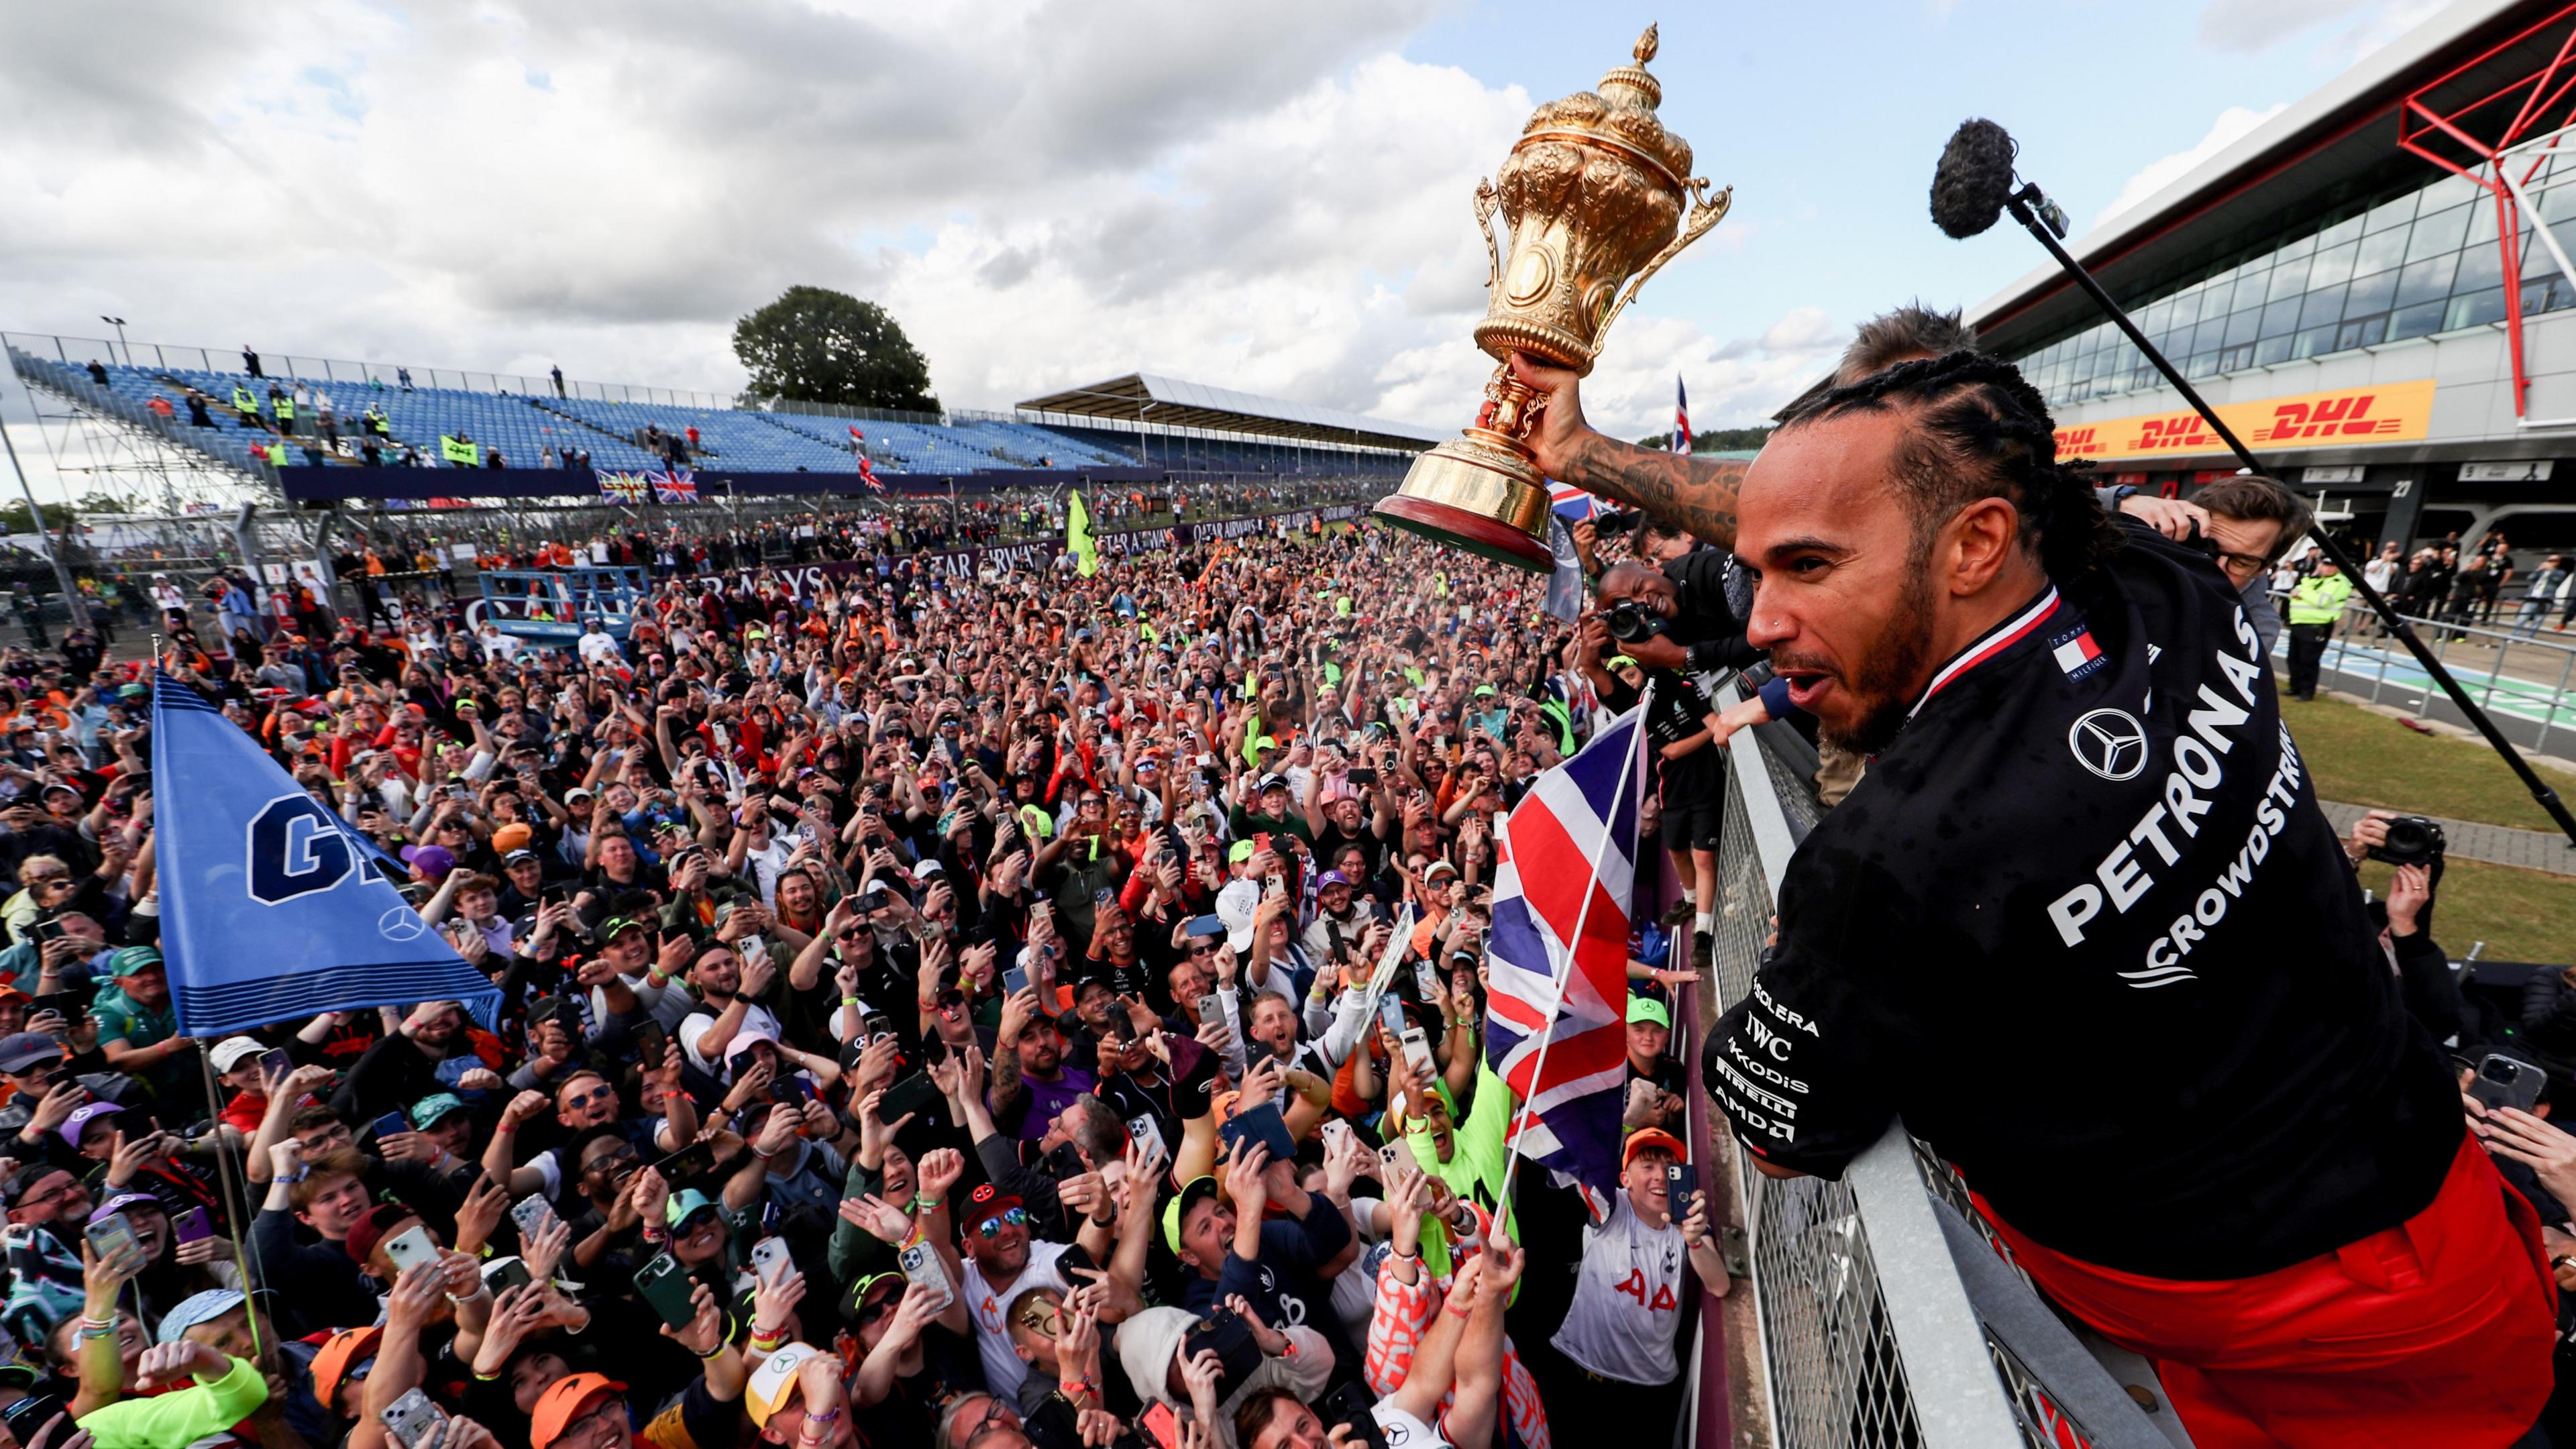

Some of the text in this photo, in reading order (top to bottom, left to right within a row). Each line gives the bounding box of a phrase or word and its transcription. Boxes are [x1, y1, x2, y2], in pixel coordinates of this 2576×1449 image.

[2139, 416, 2206, 449] DHL
[2270, 396, 2381, 439] DHL
[2054, 428, 2096, 455] DHL
[2392, 480, 2413, 497] 27
[1193, 521, 1223, 540] QATAR
[1224, 518, 1256, 538] AIRWAYS
[2053, 624, 2086, 645] TOMMY
[2072, 655, 2108, 680] HILFIGER
[2047, 605, 2261, 948] PETRONAS
[2146, 716, 2300, 969] CROWDSTRIK
[1745, 1010, 1792, 1061] IWC
[1715, 1055, 1798, 1120] PIRELLI
[1715, 1085, 1767, 1130] AMD
